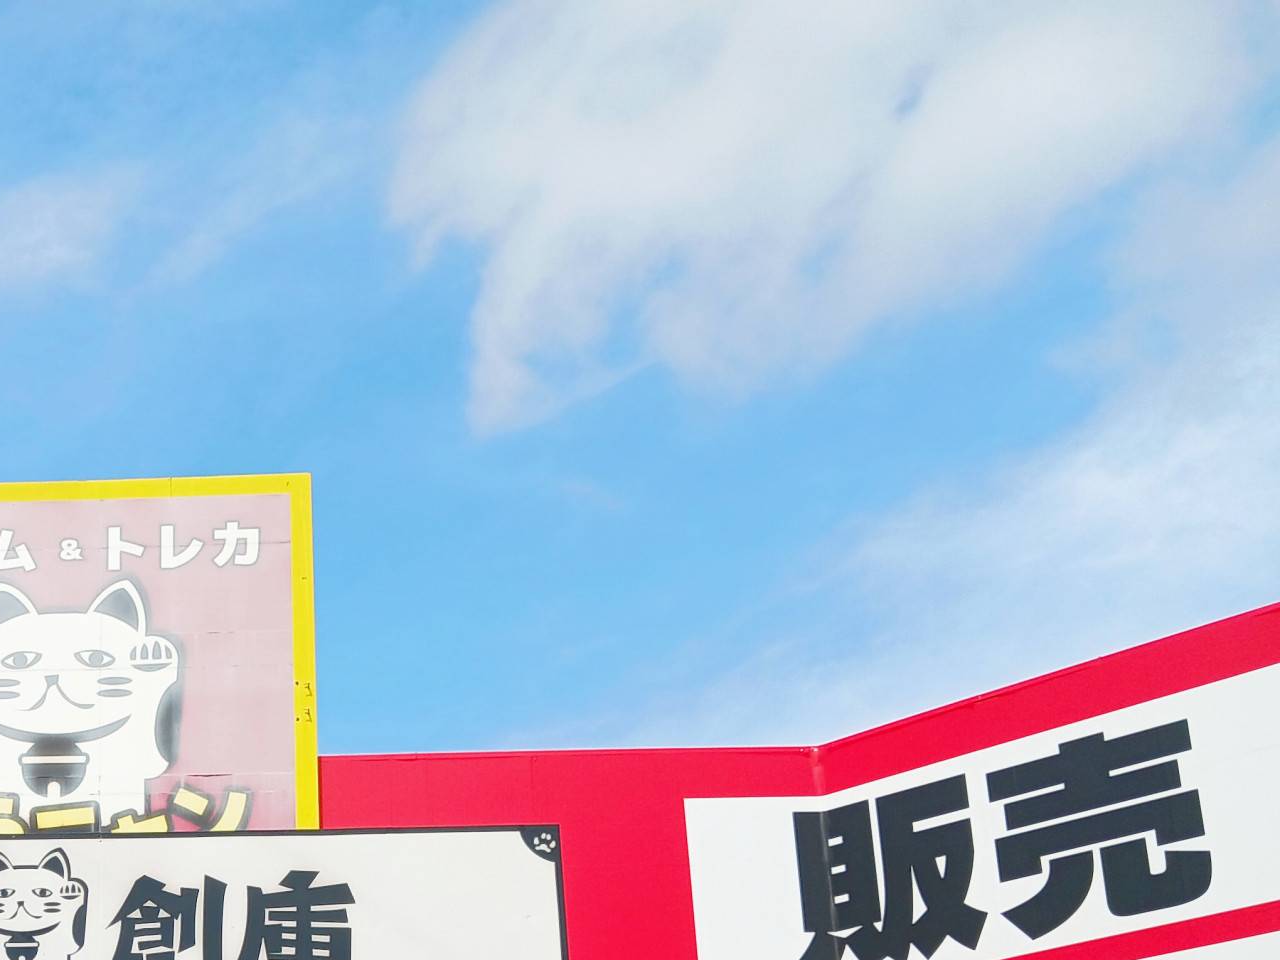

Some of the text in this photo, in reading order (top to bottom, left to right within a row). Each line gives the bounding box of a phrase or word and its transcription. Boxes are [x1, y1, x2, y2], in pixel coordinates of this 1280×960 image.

[59, 538, 84, 561] &
[106, 520, 261, 572] トレカ
